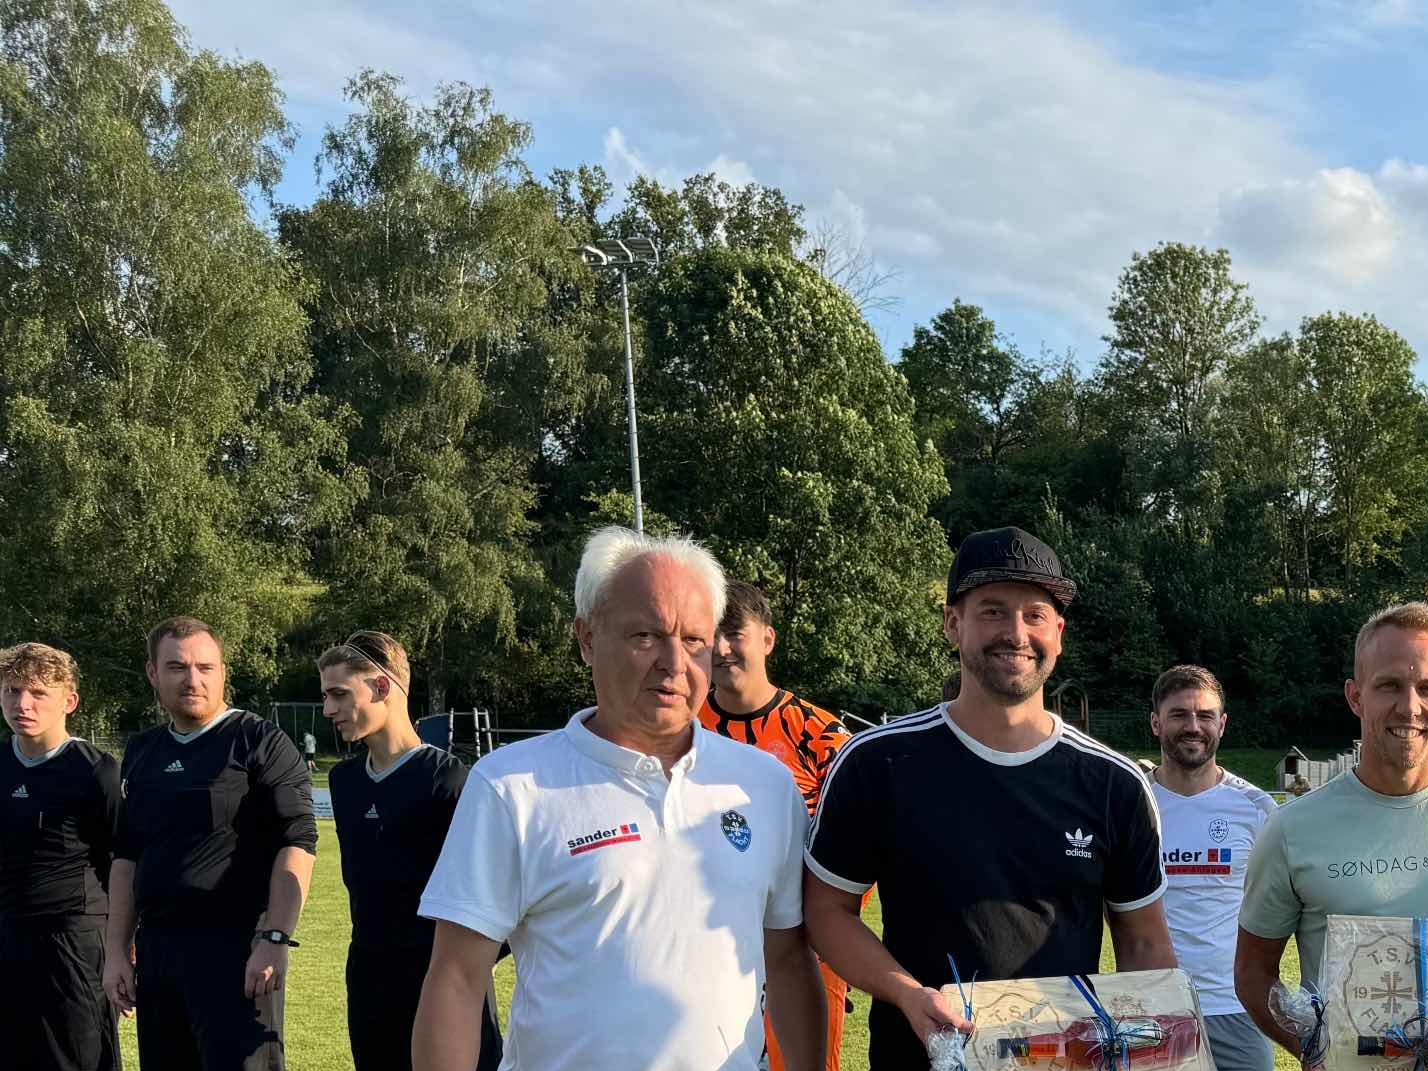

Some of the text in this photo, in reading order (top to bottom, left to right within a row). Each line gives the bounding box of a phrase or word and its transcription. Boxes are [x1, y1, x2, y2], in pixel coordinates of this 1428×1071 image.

[567, 828, 617, 848] sander
[1065, 848, 1092, 859] adidas
[1162, 848, 1202, 862] der
[1327, 855, 1419, 879] SØNDAG
